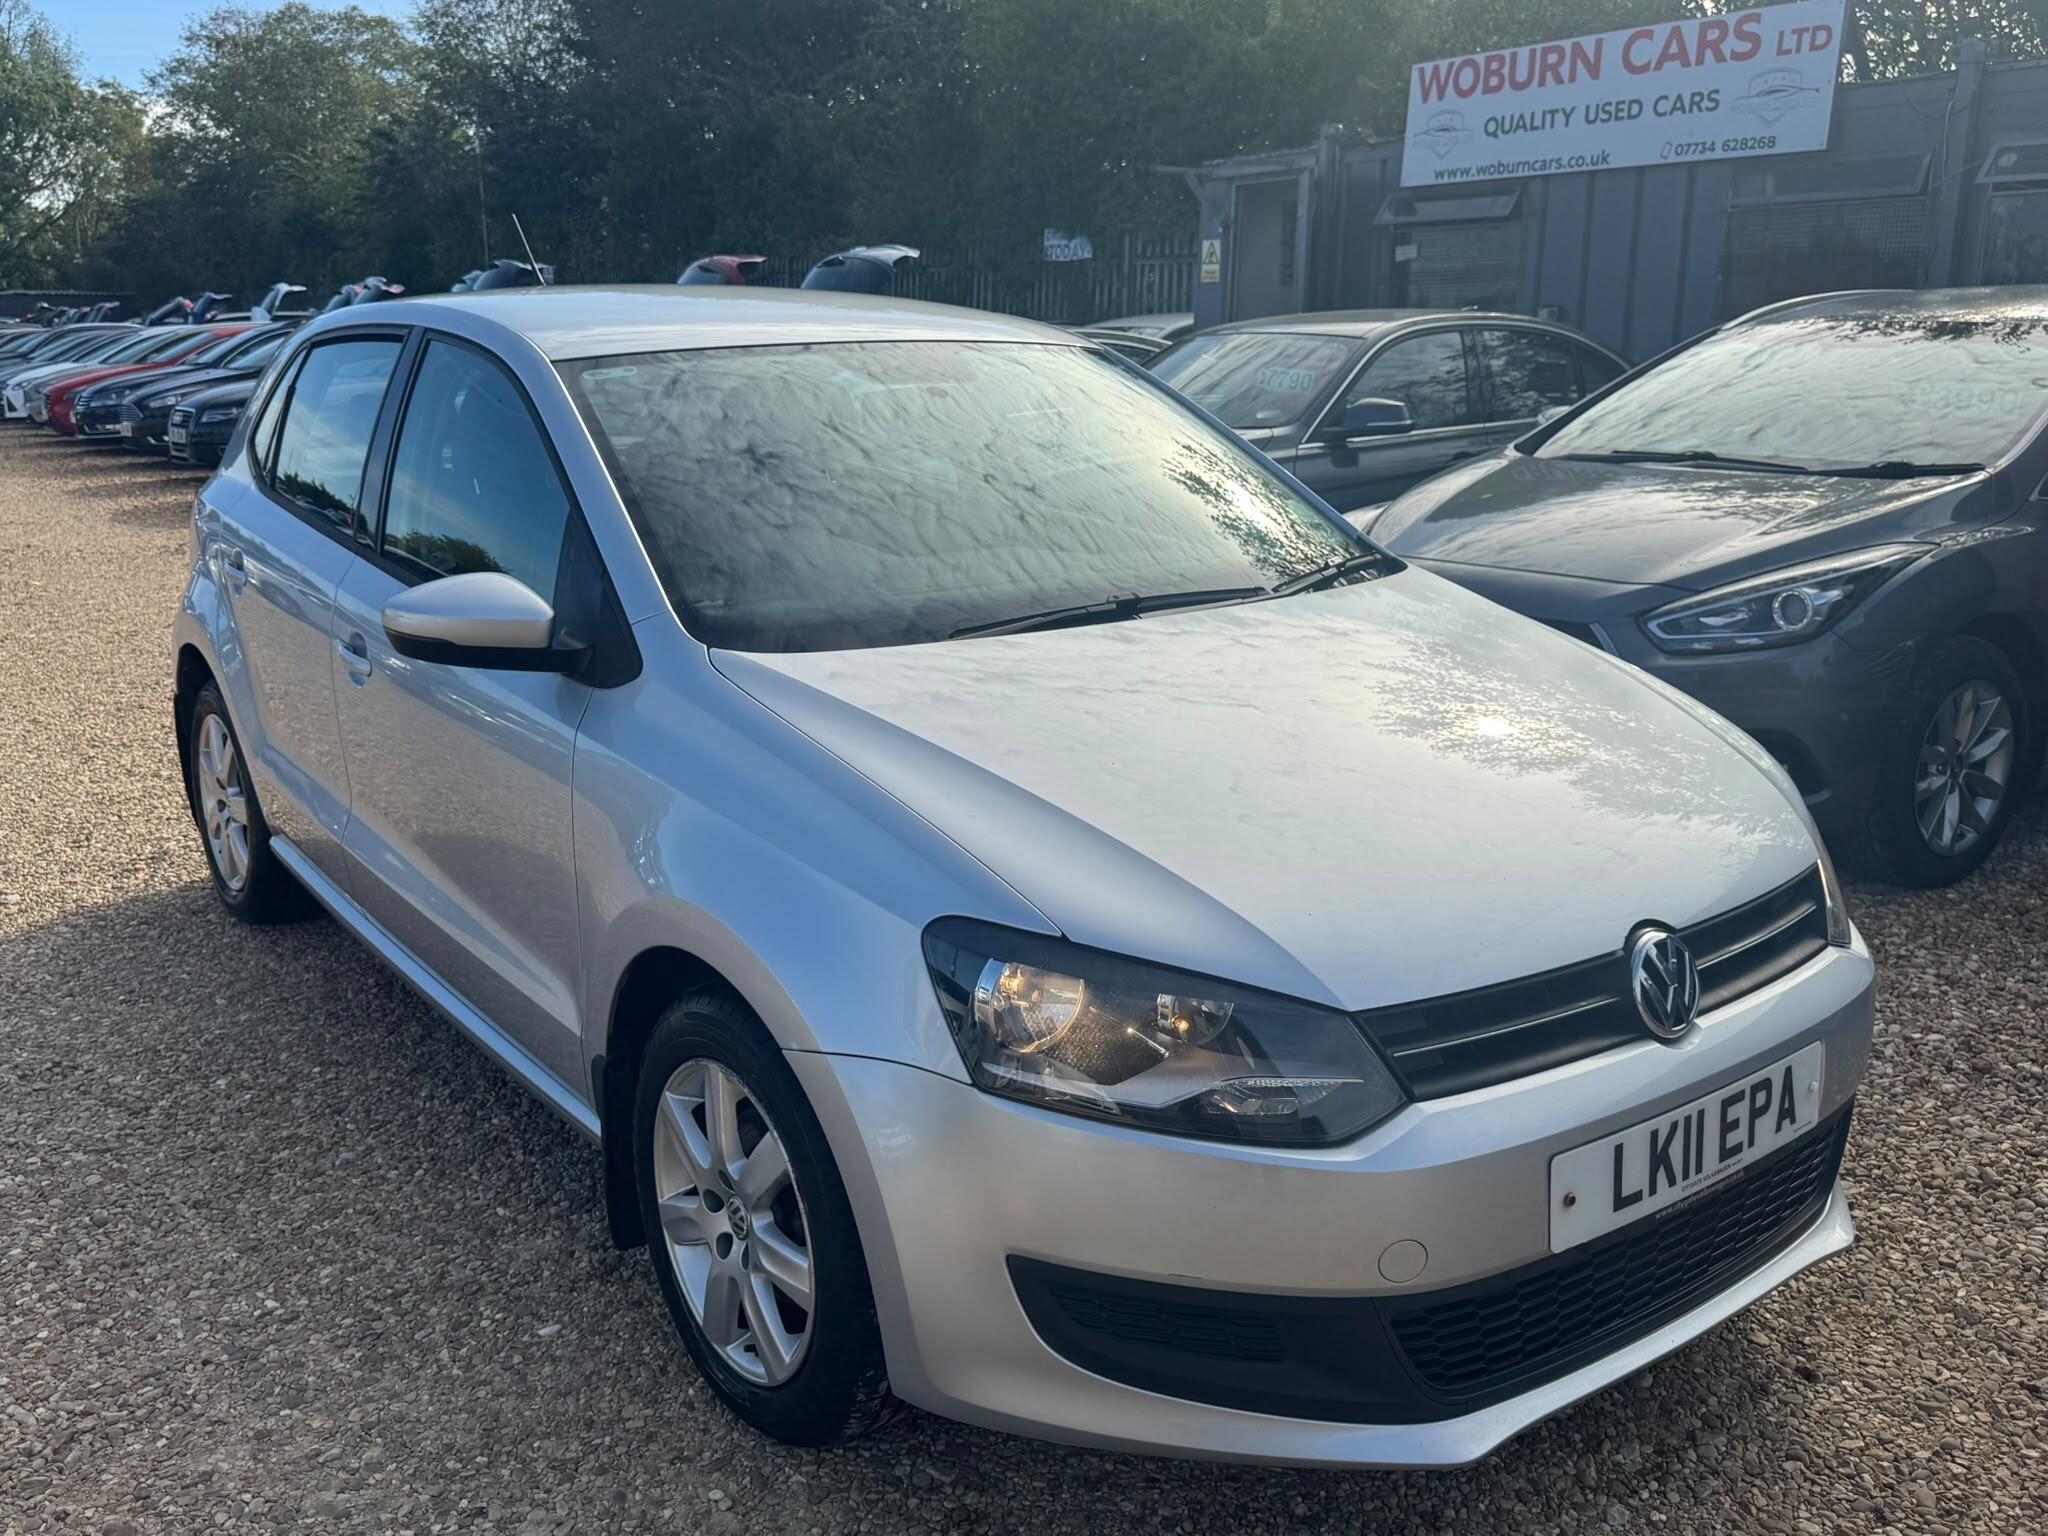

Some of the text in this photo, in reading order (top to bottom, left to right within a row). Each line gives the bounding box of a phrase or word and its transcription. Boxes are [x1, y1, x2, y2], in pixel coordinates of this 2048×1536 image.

[1418, 12, 1833, 104] WOBURN CARS LTD
[1484, 106, 1577, 138] QUALITY
[1584, 98, 1643, 125] USED
[1653, 89, 1720, 117] CARS
[1434, 149, 1610, 181] www.woburncars.co.uk
[1674, 135, 1776, 157] 07734 628268
[1613, 1064, 1797, 1212] LK11 EPA
